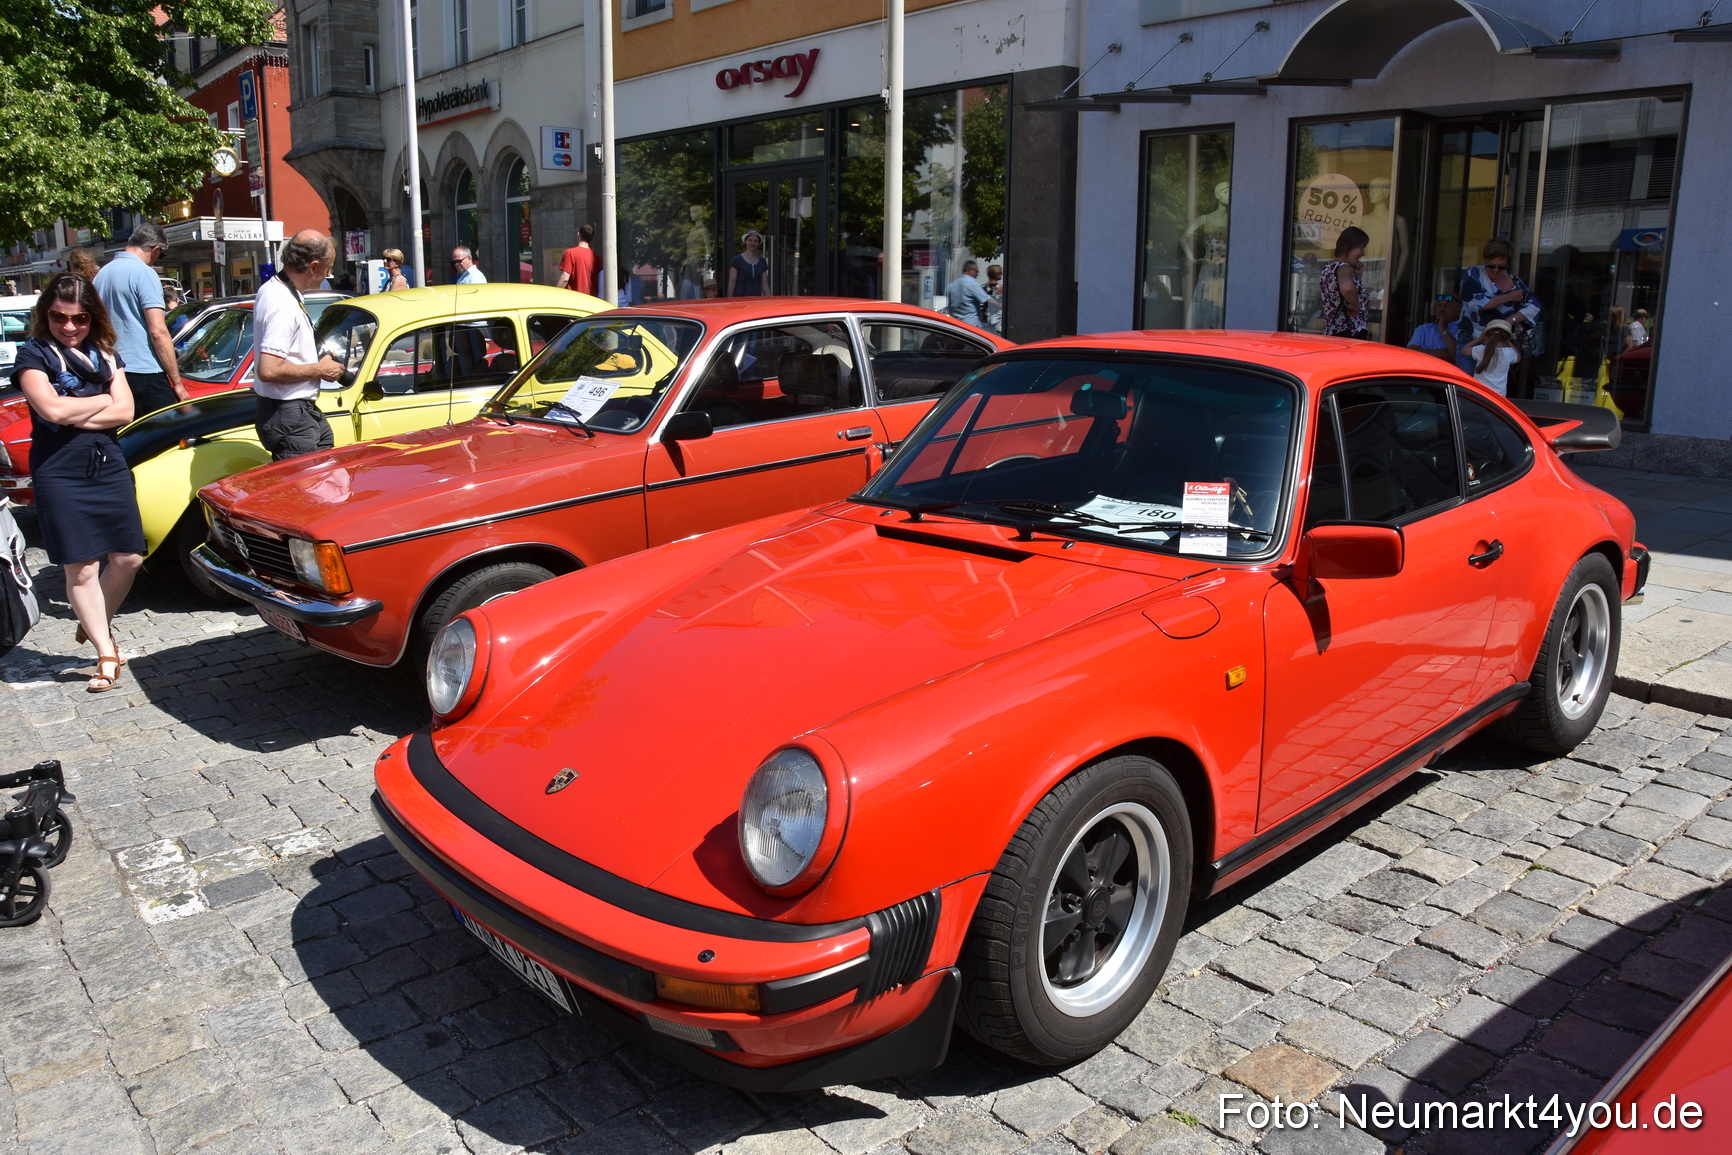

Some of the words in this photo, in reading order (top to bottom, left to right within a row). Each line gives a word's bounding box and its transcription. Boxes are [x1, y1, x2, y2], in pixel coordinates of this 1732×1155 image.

[716, 48, 820, 98] orsay
[242, 79, 251, 114] P
[418, 78, 489, 122] HypoVereinsbank
[1304, 209, 1354, 228] Rabatt
[588, 386, 608, 397] 496
[1136, 509, 1177, 520] 180
